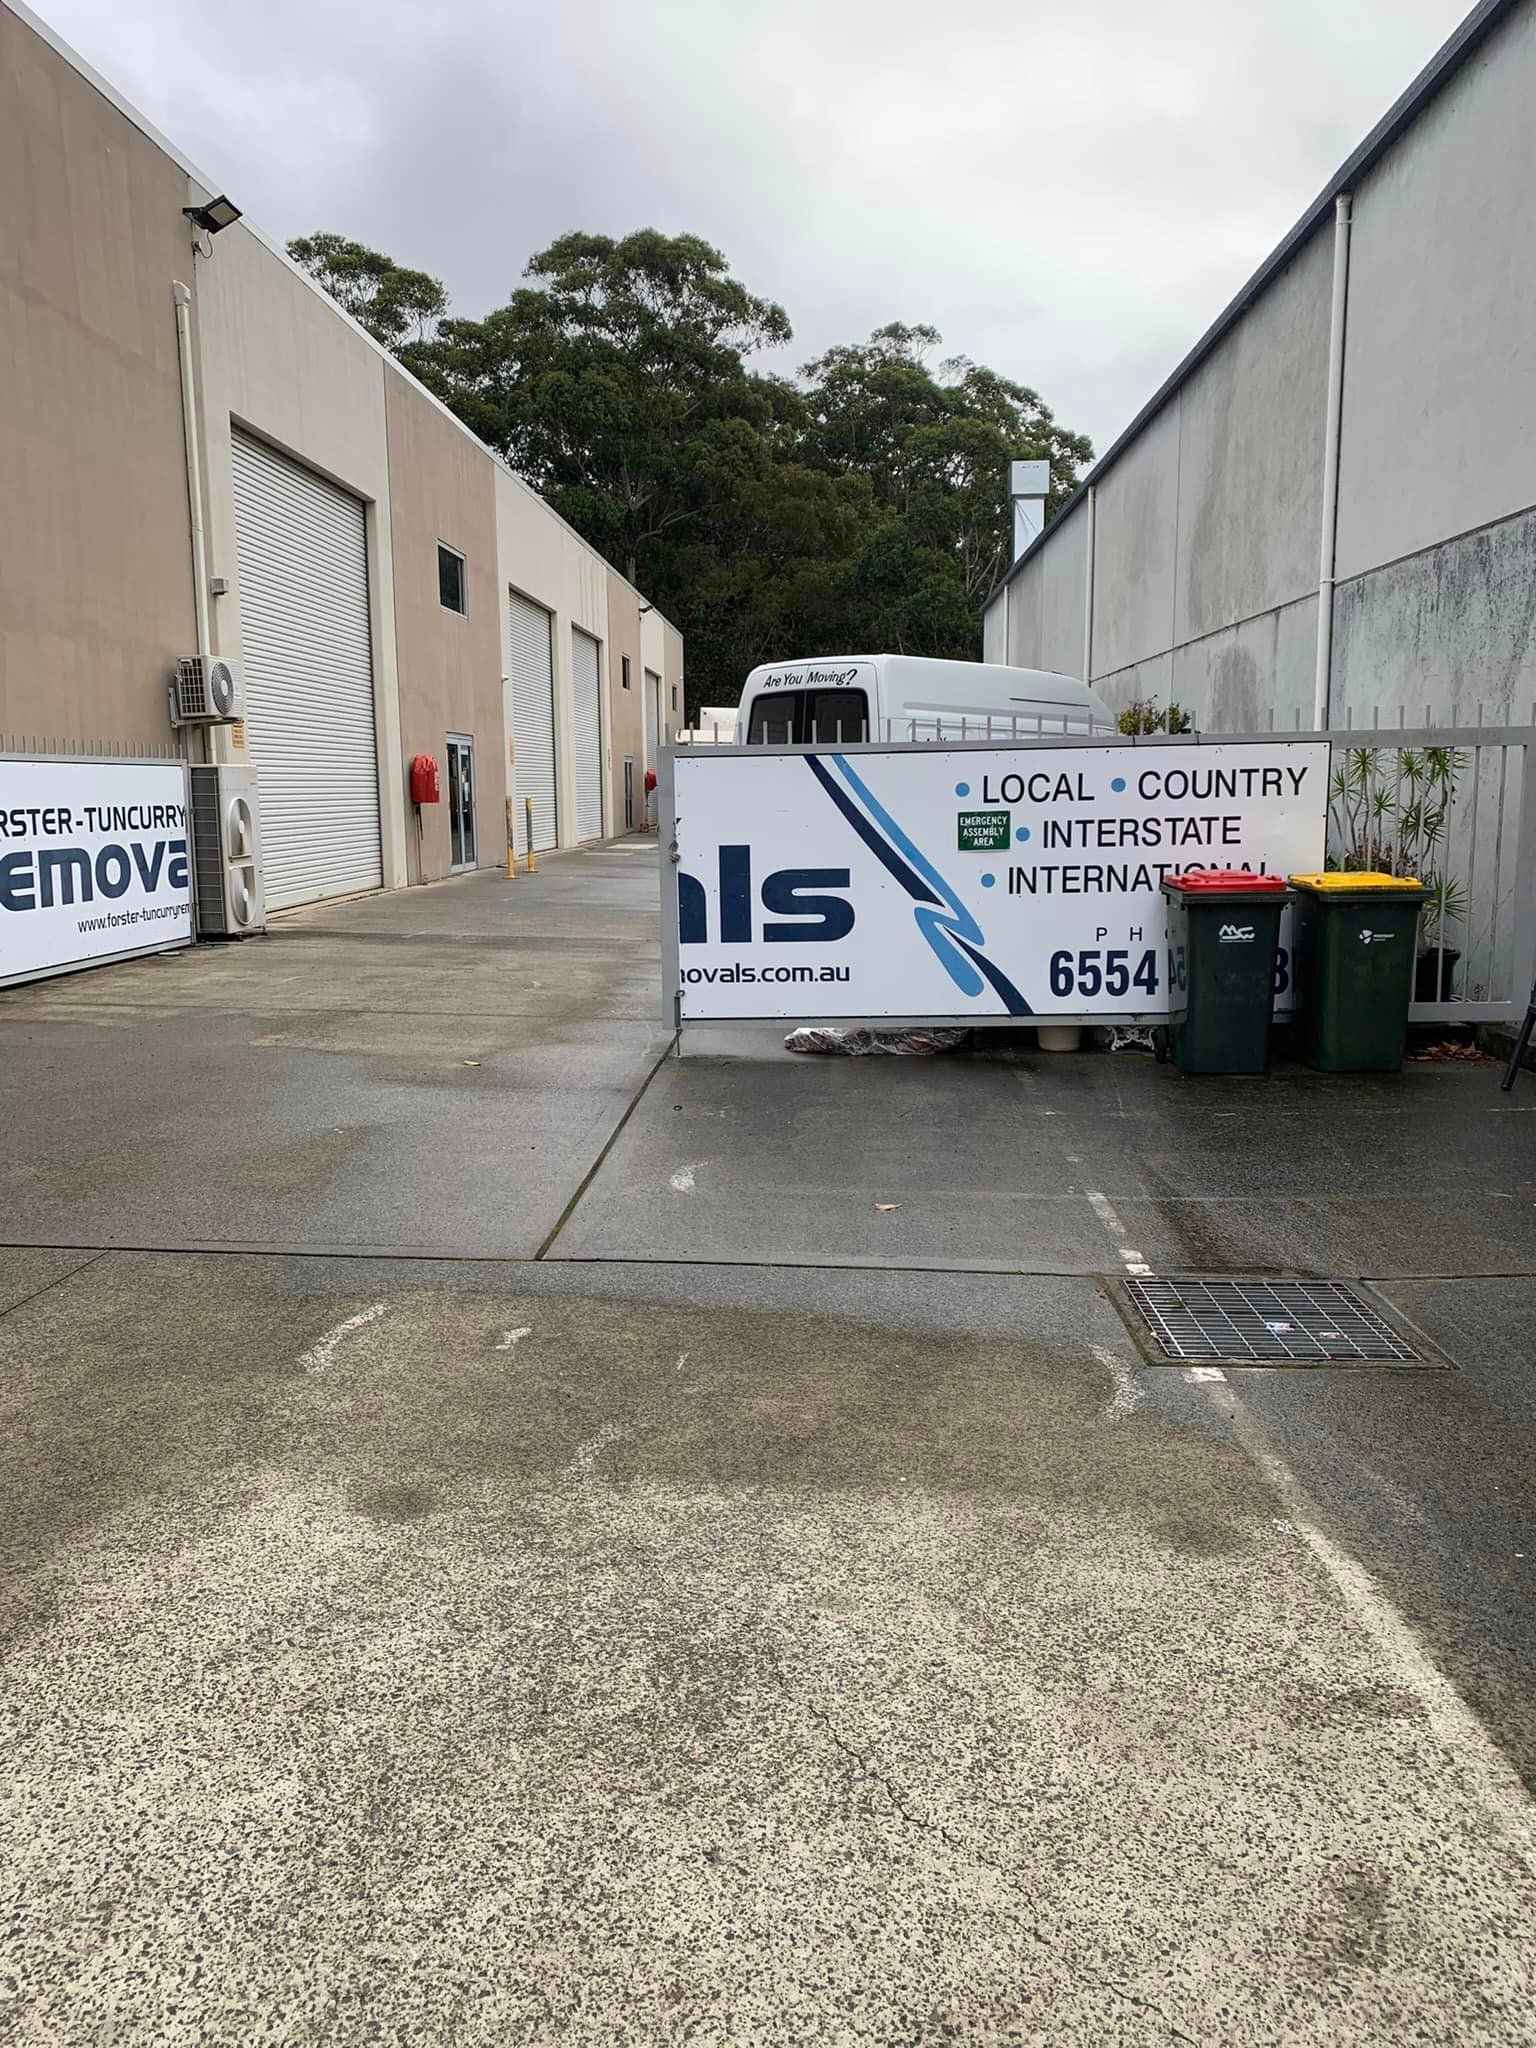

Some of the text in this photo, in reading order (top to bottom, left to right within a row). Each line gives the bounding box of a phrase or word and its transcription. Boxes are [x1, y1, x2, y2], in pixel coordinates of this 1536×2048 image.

[763, 668, 858, 688] Are You Moving?
[982, 767, 1309, 804] LOCAL COUNTRY
[960, 815, 1008, 826] EMERGENCY
[962, 827, 1004, 837] ASSEMBLY
[973, 837, 994, 847] AREA
[1042, 816, 1242, 849] INTERSTATE
[1049, 949, 1159, 997] 6554
